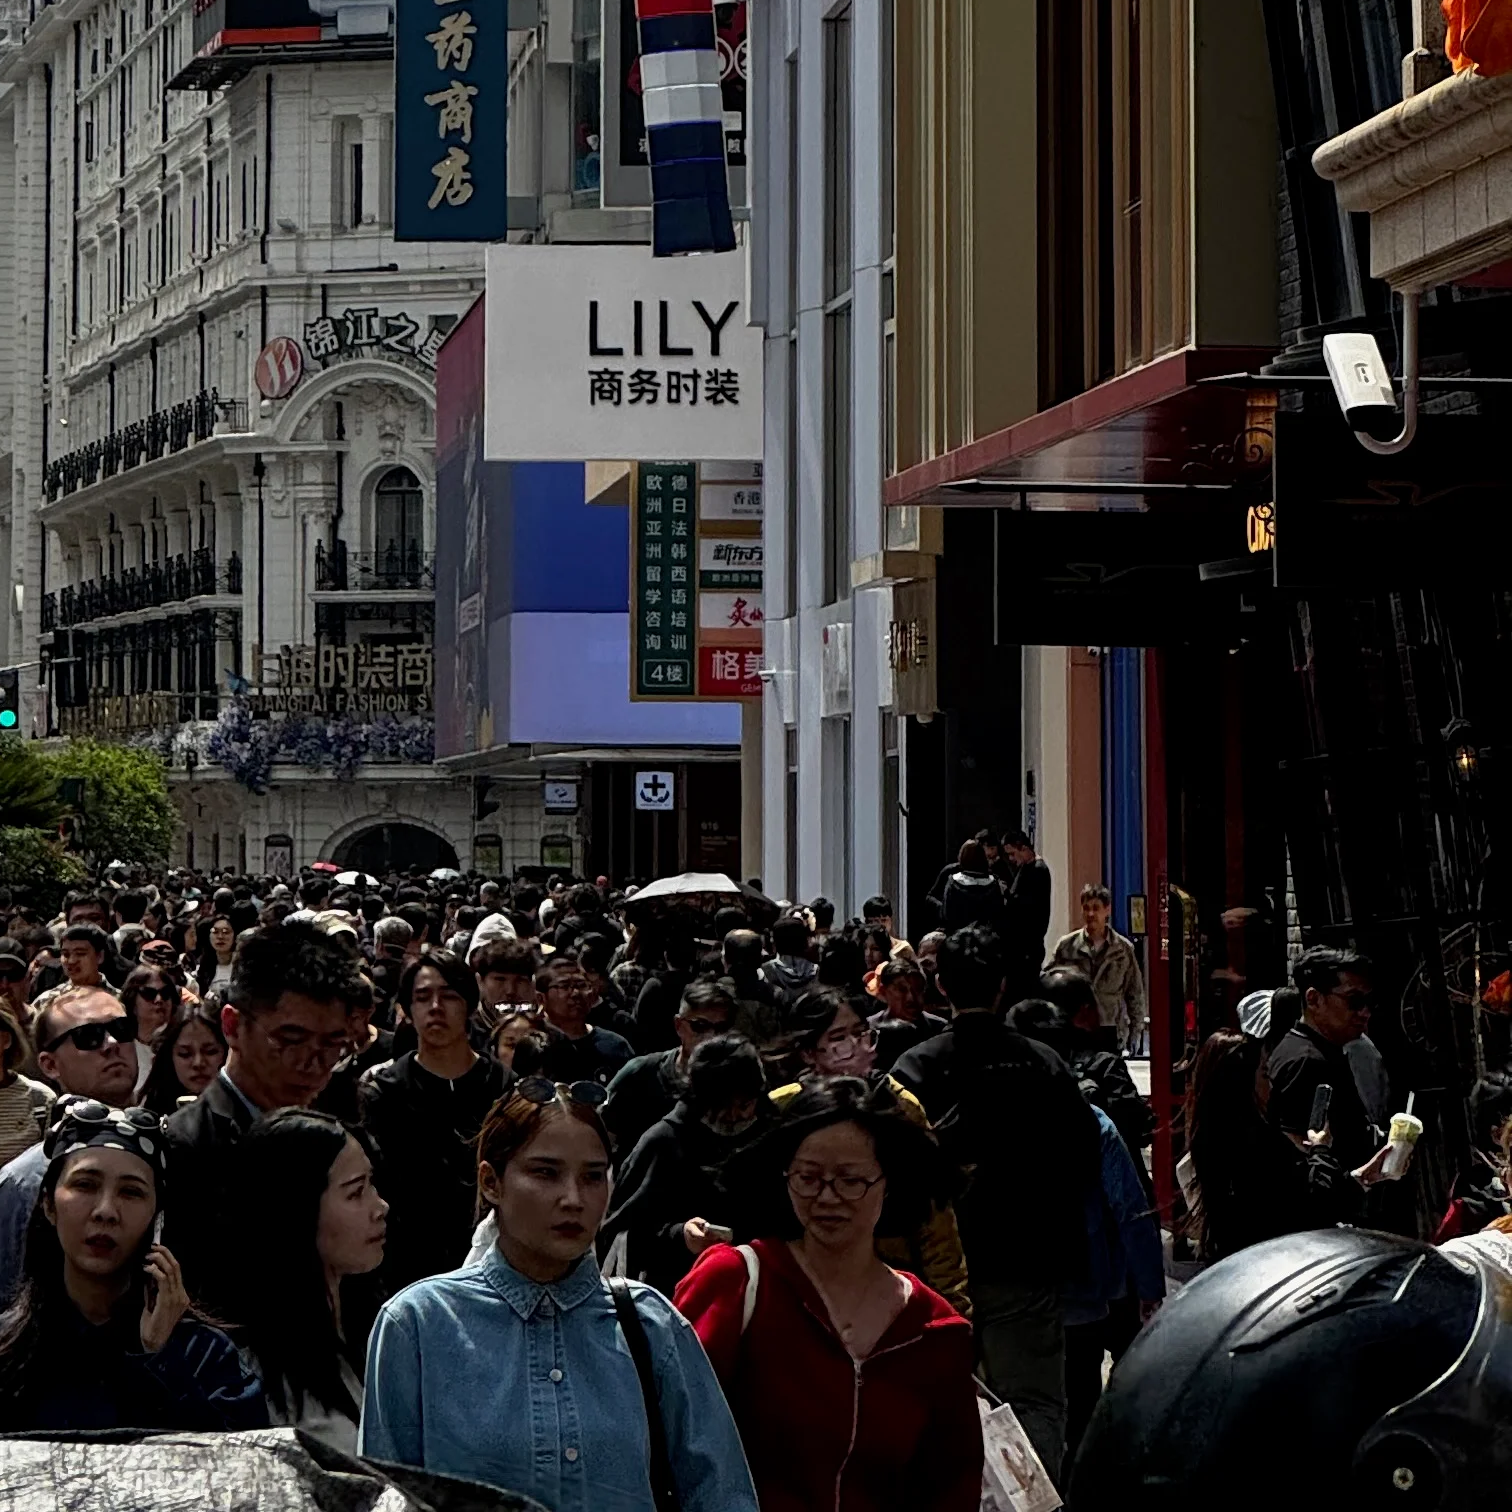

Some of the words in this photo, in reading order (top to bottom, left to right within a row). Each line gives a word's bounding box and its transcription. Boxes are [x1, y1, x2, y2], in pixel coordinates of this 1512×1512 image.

[589, 300, 740, 357] LILY
[588, 367, 740, 406] 商务时装
[645, 474, 663, 651] 欧洲亚洲留学咨询
[670, 474, 688, 651] 德日法韩西语培训
[252, 642, 435, 690] 上海时装商
[650, 664, 684, 682] 4楼
[242, 693, 329, 713] SHANGHAI
[336, 693, 409, 713] FASHION
